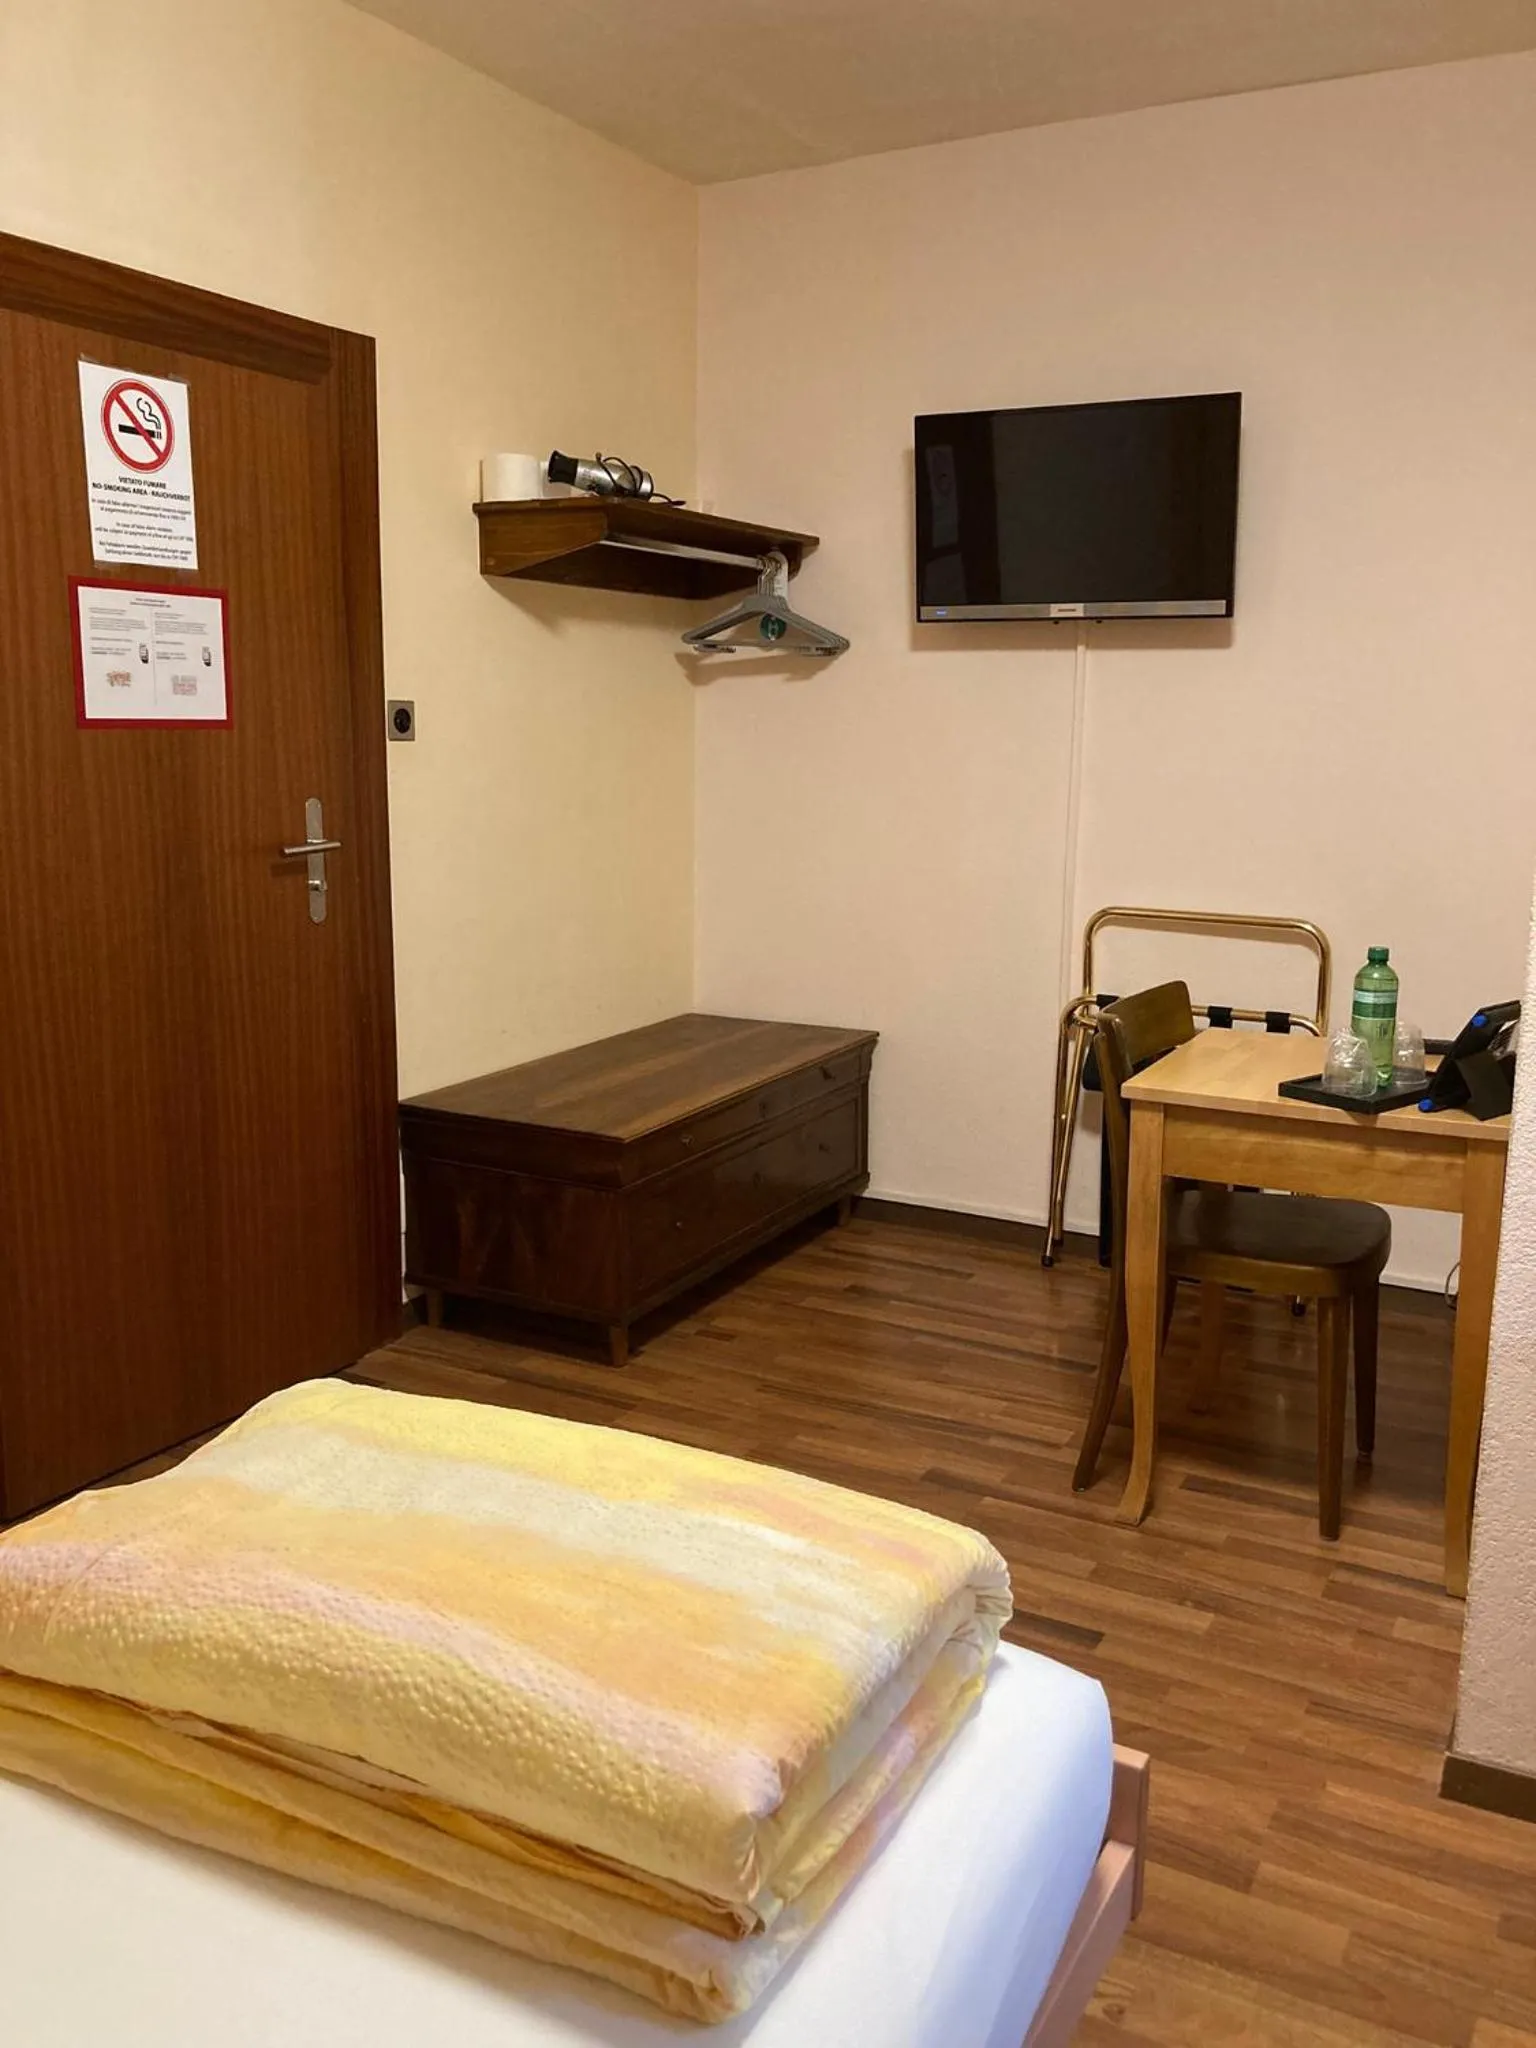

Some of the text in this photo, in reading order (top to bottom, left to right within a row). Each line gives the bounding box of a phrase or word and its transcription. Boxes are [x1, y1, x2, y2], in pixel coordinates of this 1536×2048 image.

[119, 476, 166, 489] VIETATO FUMARE
[132, 487, 148, 495] AREA
